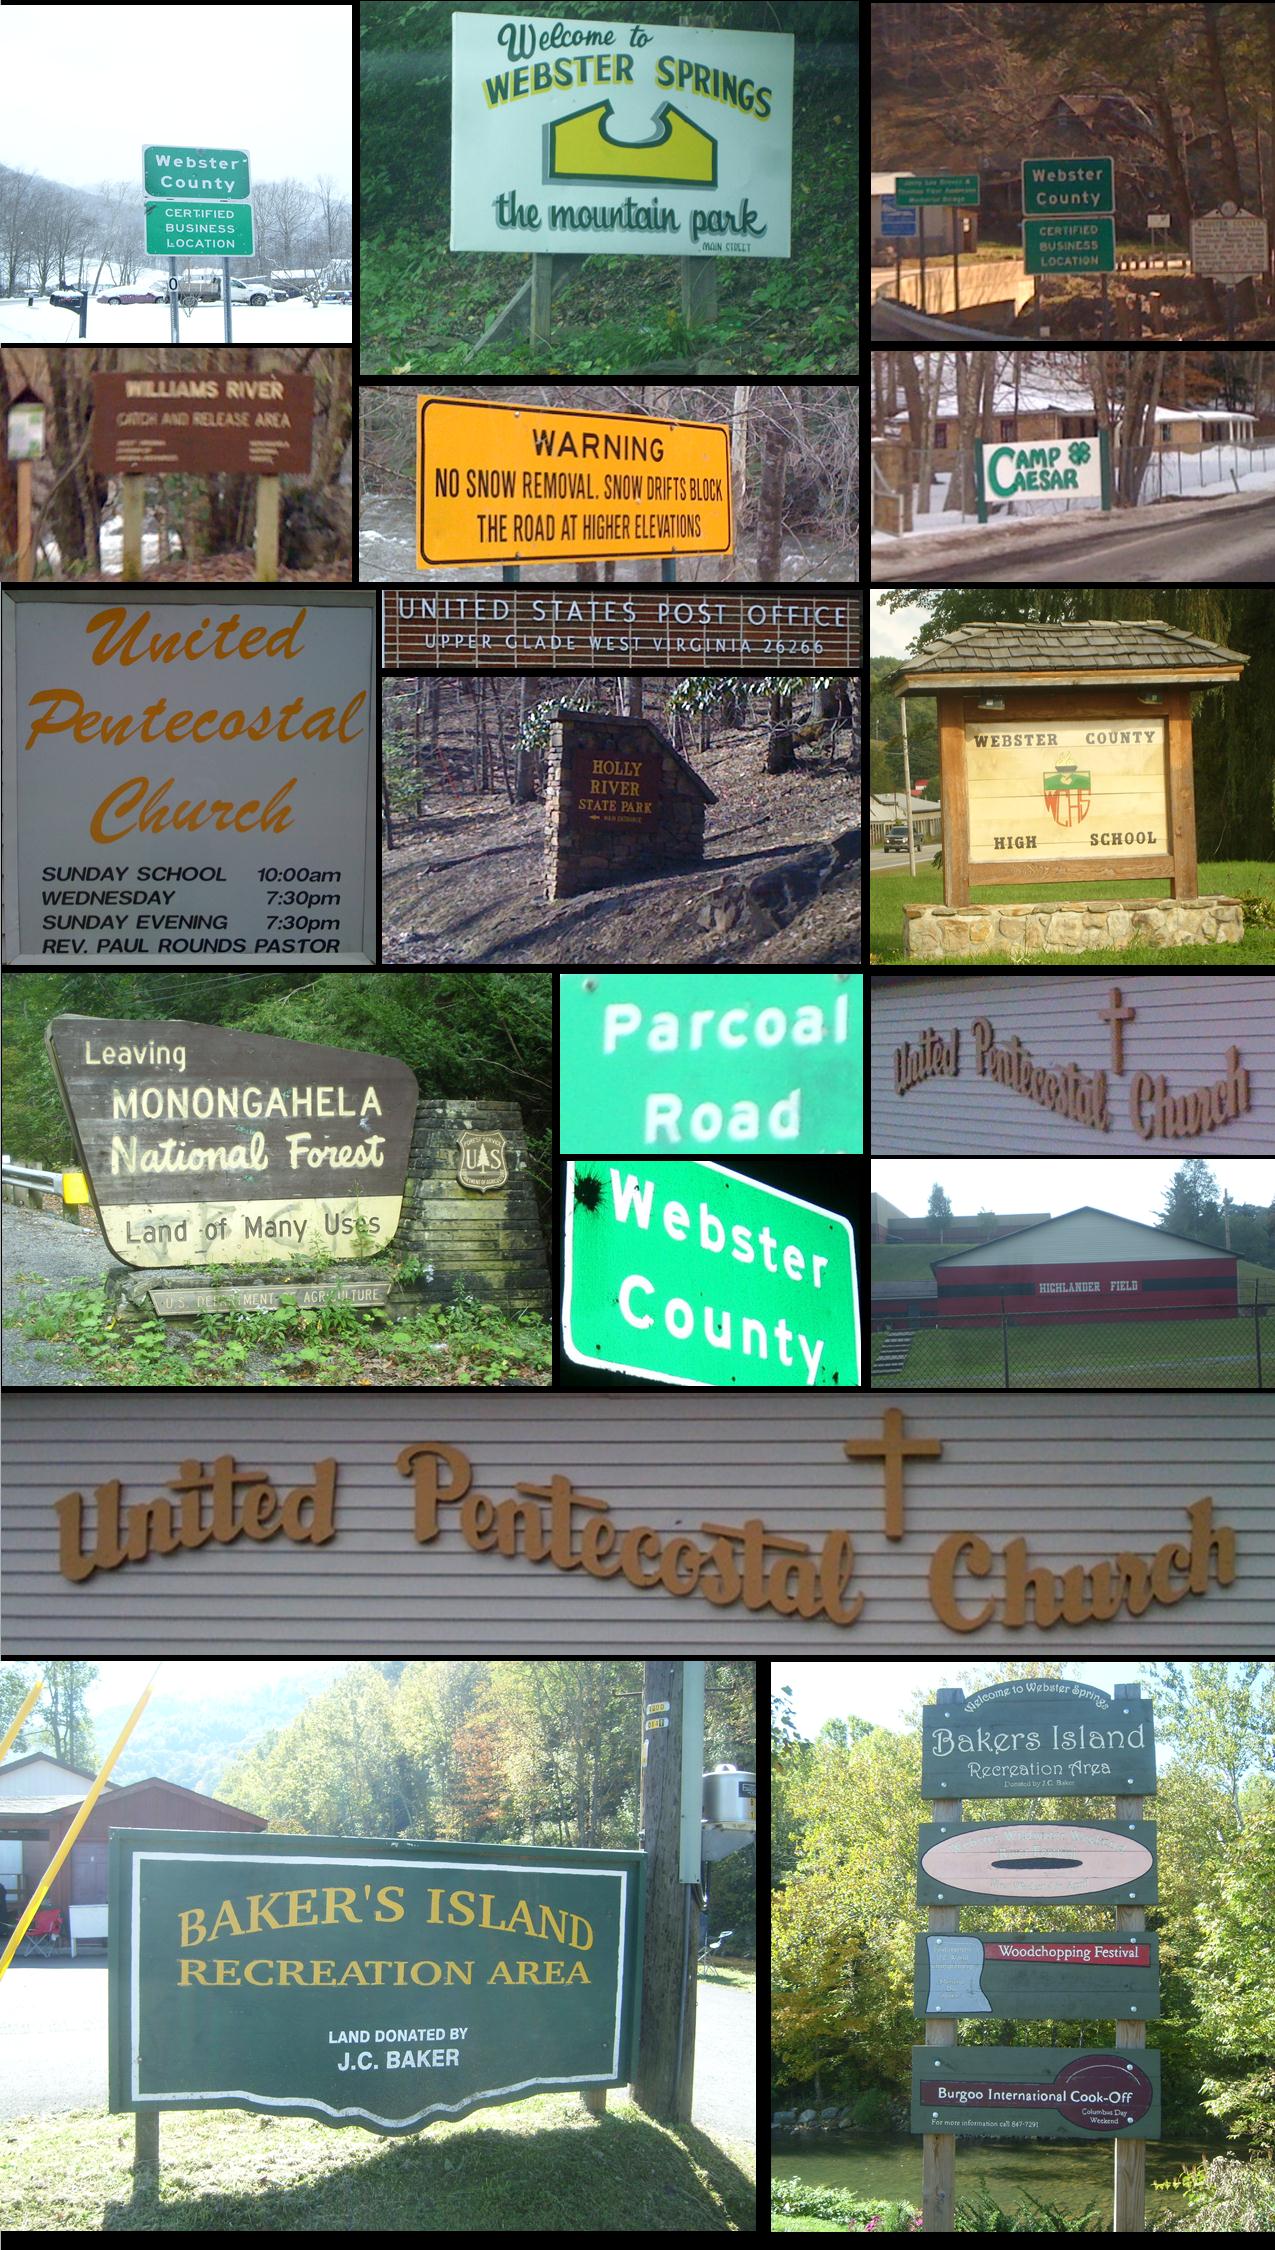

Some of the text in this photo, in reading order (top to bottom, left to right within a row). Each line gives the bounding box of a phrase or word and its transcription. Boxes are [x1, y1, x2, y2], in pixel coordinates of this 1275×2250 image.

[498, 22, 654, 62] Welcome to
[483, 54, 773, 120] WEBSTER SPRINGS
[155, 153, 240, 170] Webster
[160, 175, 235, 193] County
[1032, 167, 1104, 183] Webster
[1036, 191, 1102, 208] County
[164, 208, 235, 219] CERTIFIED
[493, 190, 768, 243] the mountain park
[165, 223, 235, 233] BUSINESS
[1039, 225, 1098, 236] CERTIFIED
[166, 238, 235, 248] LOCATION
[1039, 240, 1098, 251] BUSINESS
[1041, 255, 1099, 266] LOCATION
[169, 277, 178, 291] 0
[125, 380, 284, 400] WILLIAMS RIVER
[116, 412, 292, 428] CATCH AND RELEASE AREA
[533, 428, 665, 462] WARNING
[435, 468, 723, 503] NO SNOW REMOVAL. SNOW DRIFTS BLOCK
[477, 513, 702, 543] THE ROAD AT HIGHER ELEVATIONS
[399, 598, 847, 627] UNITED STATES POST OFFICE
[85, 607, 307, 667] United
[425, 634, 824, 654] UPPER GLADE WEST VIRGINIA 26266
[25, 688, 367, 750] Pentecostal
[974, 731, 1156, 748] WEBSTER COUNTY
[592, 759, 642, 777] HOLLY
[590, 780, 640, 797] RIVER
[90, 776, 298, 844] Church
[578, 799, 653, 814] STATE PARK
[994, 832, 1157, 850] HIGH SCHOOL
[42, 866, 341, 883] SUNDAY SCHOOL 10:00am
[42, 890, 341, 909] WEDNESDAY 7:30pm
[42, 915, 340, 934] SUNDAY EVENING 7:30pm
[42, 938, 340, 954] REV. PAUL ROUNDS PASTOR
[603, 993, 849, 1056] Parcoal
[85, 1040, 187, 1072] Leaving
[893, 1016, 1252, 1140] United Pentecostal Church
[112, 1086, 382, 1120] MONONGAHELA
[644, 1087, 801, 1144] Road
[111, 1131, 386, 1175] National Forest
[125, 1213, 381, 1245] Land of Many Uses
[609, 1168, 829, 1288] Webster
[1040, 1280, 1138, 1294] HIGHLANDER FIELD
[165, 1297, 188, 1309] U.S.
[303, 1288, 379, 1303] AGRCULTURE
[618, 1274, 825, 1386] County
[54, 1441, 1236, 1633] United Pentecostal Church
[964, 1682, 1109, 1713] Welcome to Webster Springs
[932, 1724, 1145, 1757] Bakers Island
[968, 1760, 1111, 1780] Recreation Area
[178, 1883, 595, 1951] BAKER'S ISLAND
[998, 1944, 1139, 1961] Woodchopping Festival
[177, 1959, 592, 1987] RECREATION AREA
[328, 2028, 469, 2045] LAND DONATED BY
[337, 2048, 460, 2071] J.C. BAKER
[938, 2087, 1134, 2104] Burgoo International Cook-Off
[1081, 2107, 1127, 2117] Columbus Day
[1090, 2116, 1119, 2125] Weekend
[962, 2119, 998, 2127] information
